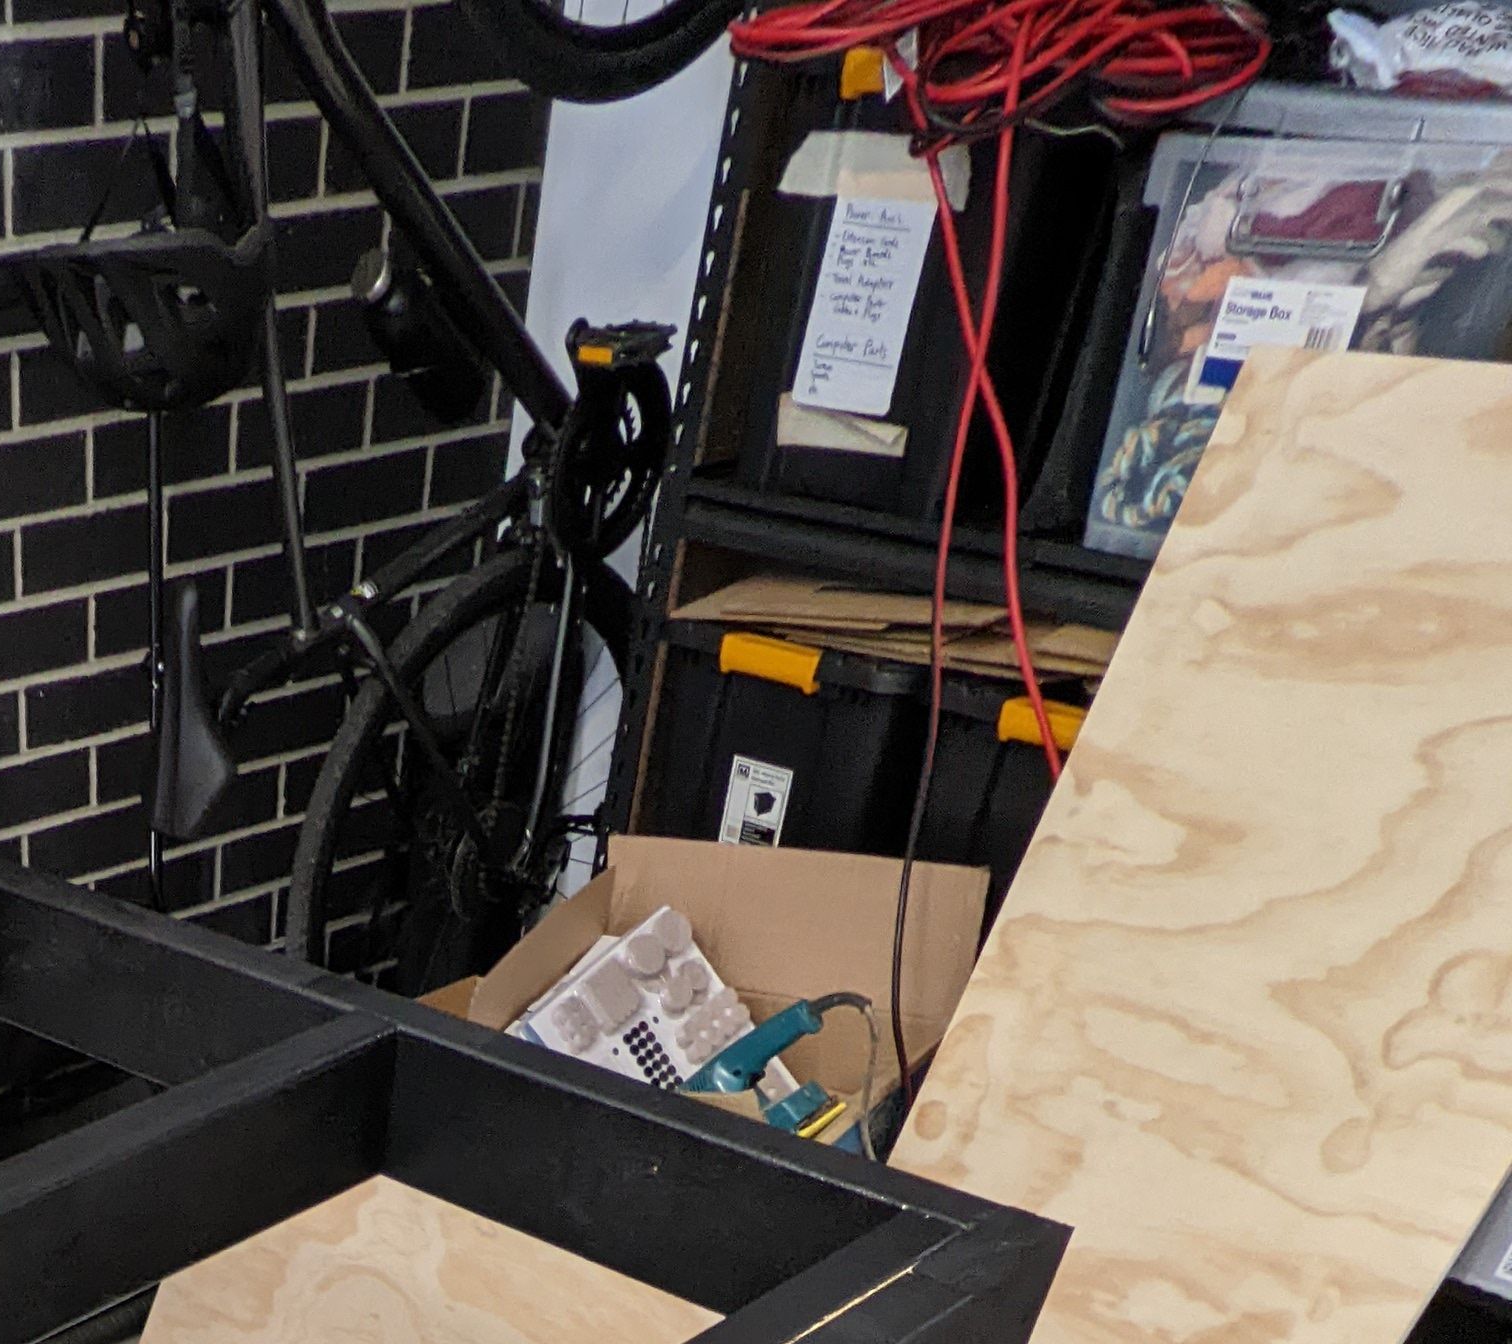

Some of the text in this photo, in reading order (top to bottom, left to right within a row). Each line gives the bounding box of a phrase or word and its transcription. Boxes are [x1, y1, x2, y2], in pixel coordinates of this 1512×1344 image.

[1226, 302, 1267, 320] Storage
[1269, 305, 1292, 320] Box
[816, 333, 888, 360] Computer Parts
